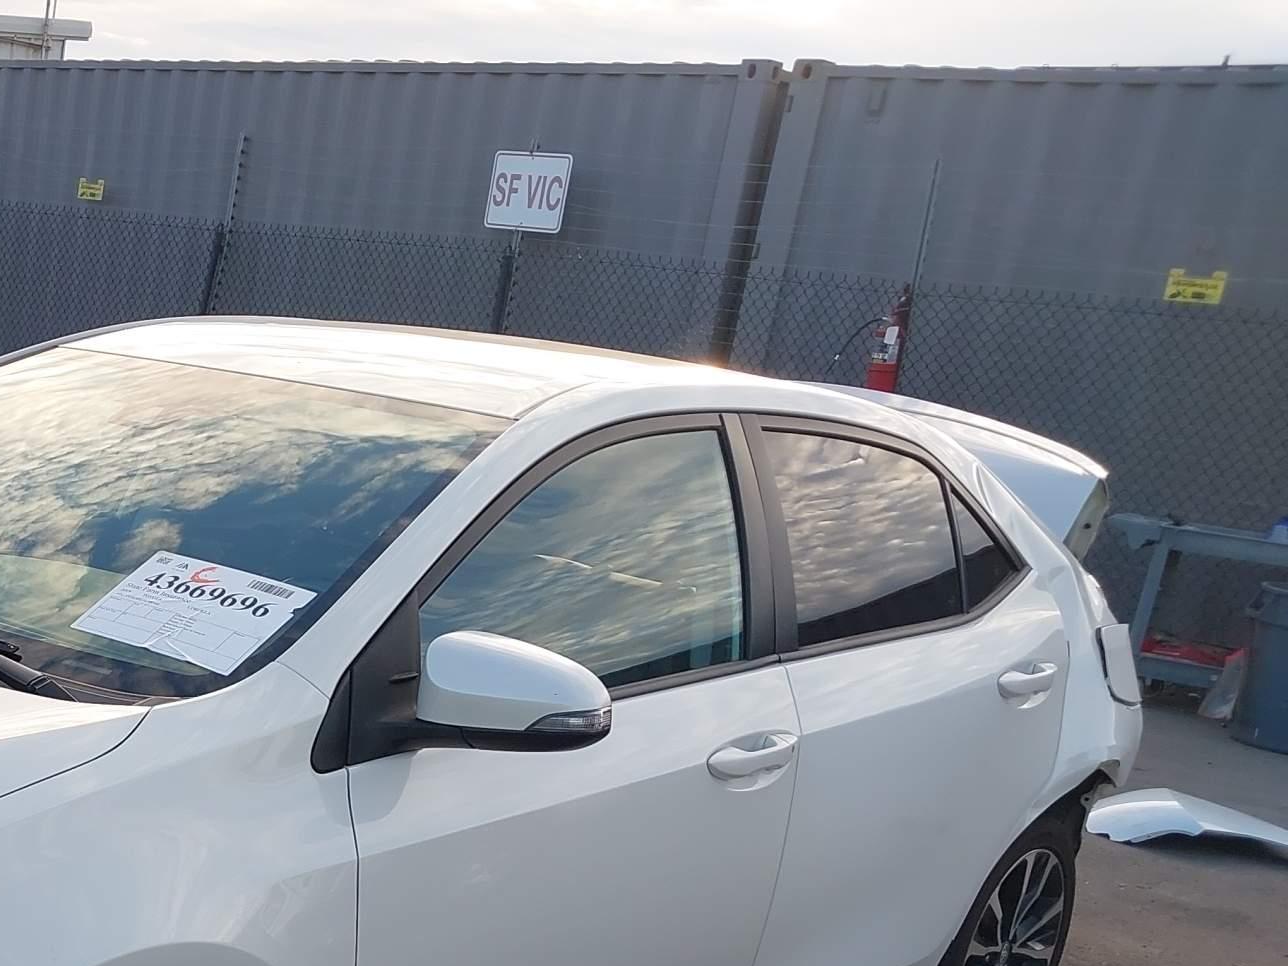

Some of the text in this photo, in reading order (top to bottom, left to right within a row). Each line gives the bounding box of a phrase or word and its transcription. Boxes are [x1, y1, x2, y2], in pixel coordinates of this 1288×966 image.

[492, 172, 563, 211] SF VIC
[144, 572, 280, 618] 43669696
